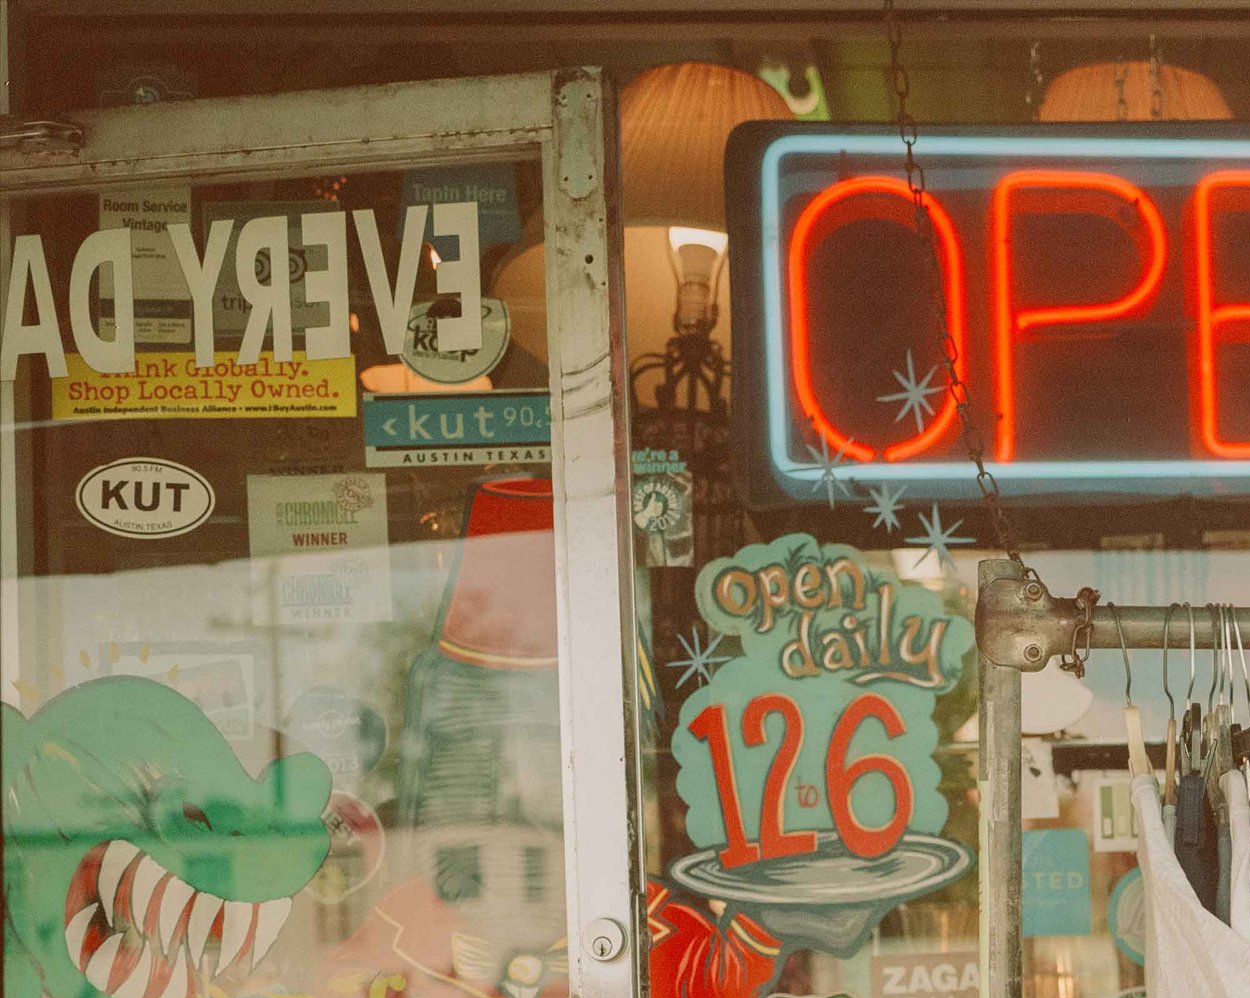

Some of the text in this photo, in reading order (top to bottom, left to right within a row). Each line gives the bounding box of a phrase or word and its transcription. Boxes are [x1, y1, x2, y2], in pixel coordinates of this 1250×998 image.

[103, 200, 187, 213] Room Service
[101, 359, 177, 378] ink
[69, 378, 339, 404] Shop Locally Owned.
[73, 406, 101, 415] Austin
[104, 405, 157, 414] Independent
[161, 405, 199, 413] Business
[202, 404, 236, 412] Alliance
[403, 449, 546, 463] AUSTIN TEXAS
[101, 480, 190, 513] KUT
[293, 532, 348, 546] WINNER
[712, 557, 866, 634] open
[780, 583, 948, 689] daily
[687, 693, 819, 870] 12
[826, 692, 914, 858] 6
